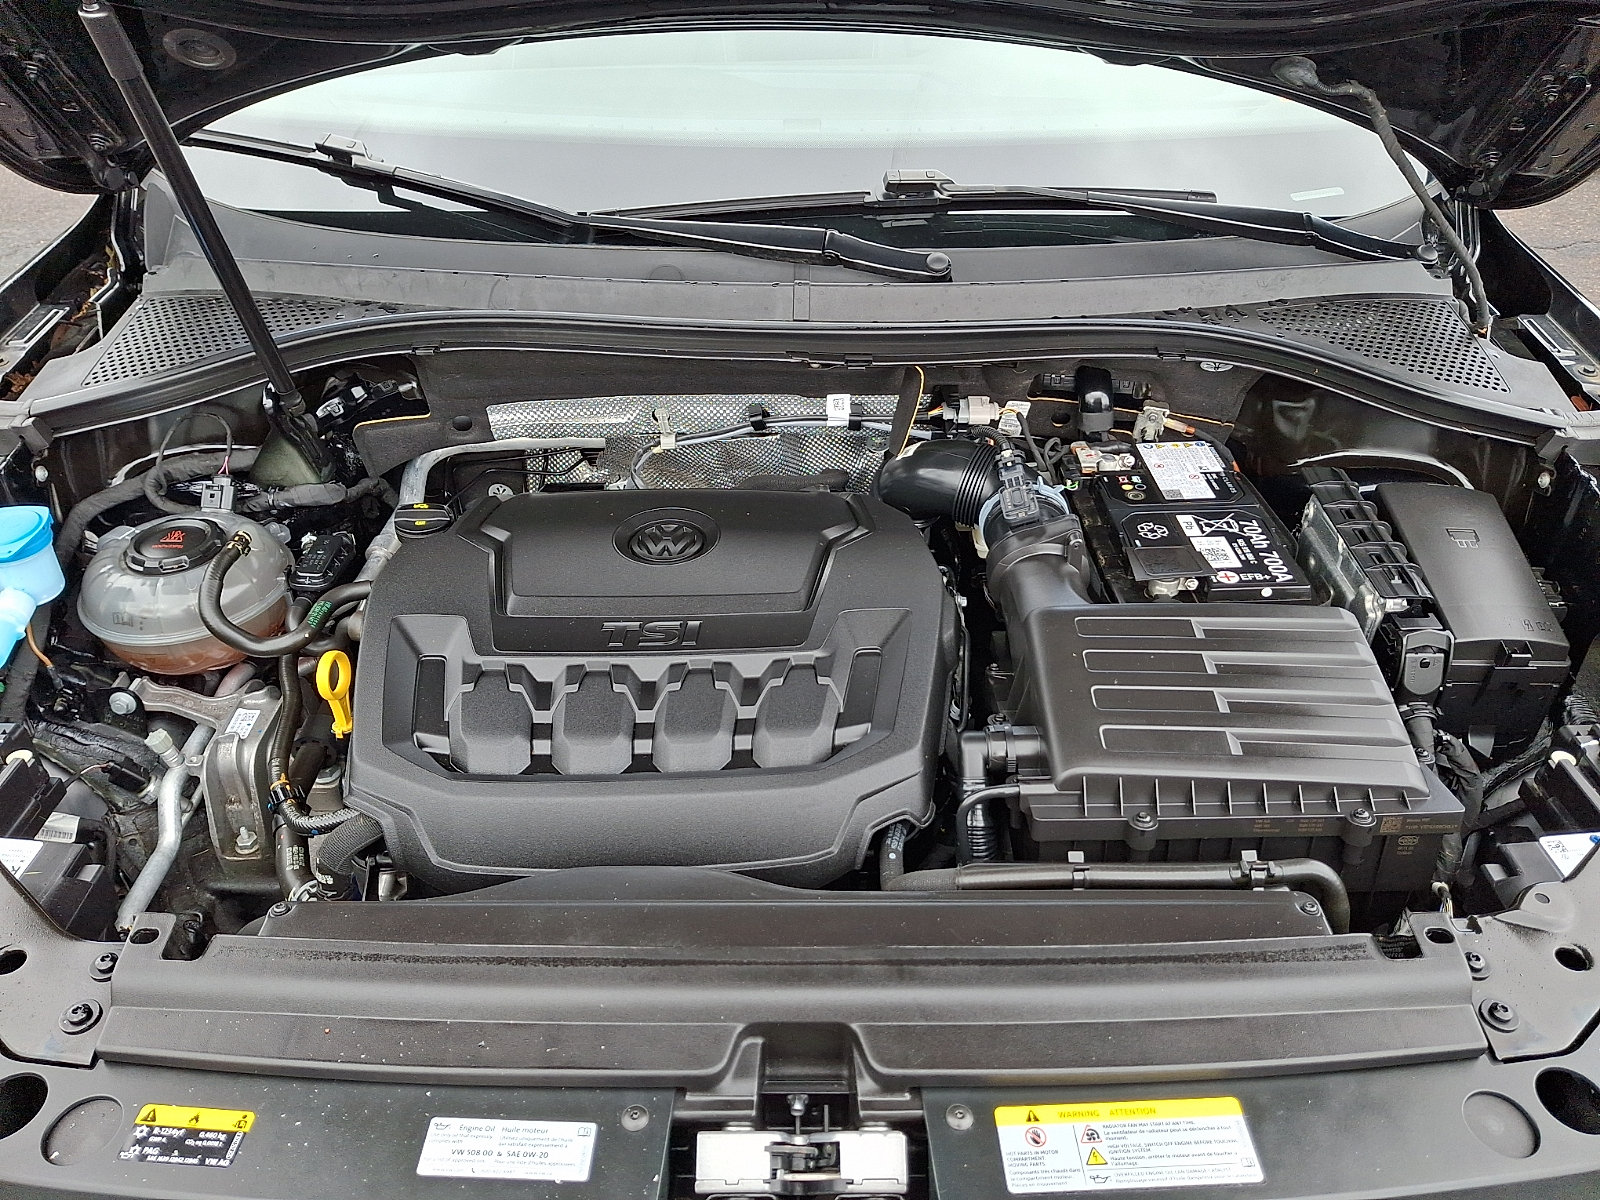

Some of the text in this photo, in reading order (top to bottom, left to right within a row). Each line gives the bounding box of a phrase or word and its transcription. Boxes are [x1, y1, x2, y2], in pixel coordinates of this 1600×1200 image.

[1182, 521, 1194, 530] Pb
[1238, 519, 1270, 548] 70Ah
[1258, 550, 1294, 582] 700A
[1240, 573, 1272, 581] EFB+
[600, 620, 704, 647] TSI
[1058, 1107, 1156, 1118] WARNING ATTENTION
[152, 1126, 186, 1138] R-1234yf
[459, 1124, 484, 1134] Engine
[142, 1147, 160, 1155] PAG
[204, 1158, 230, 1166] VW AG
